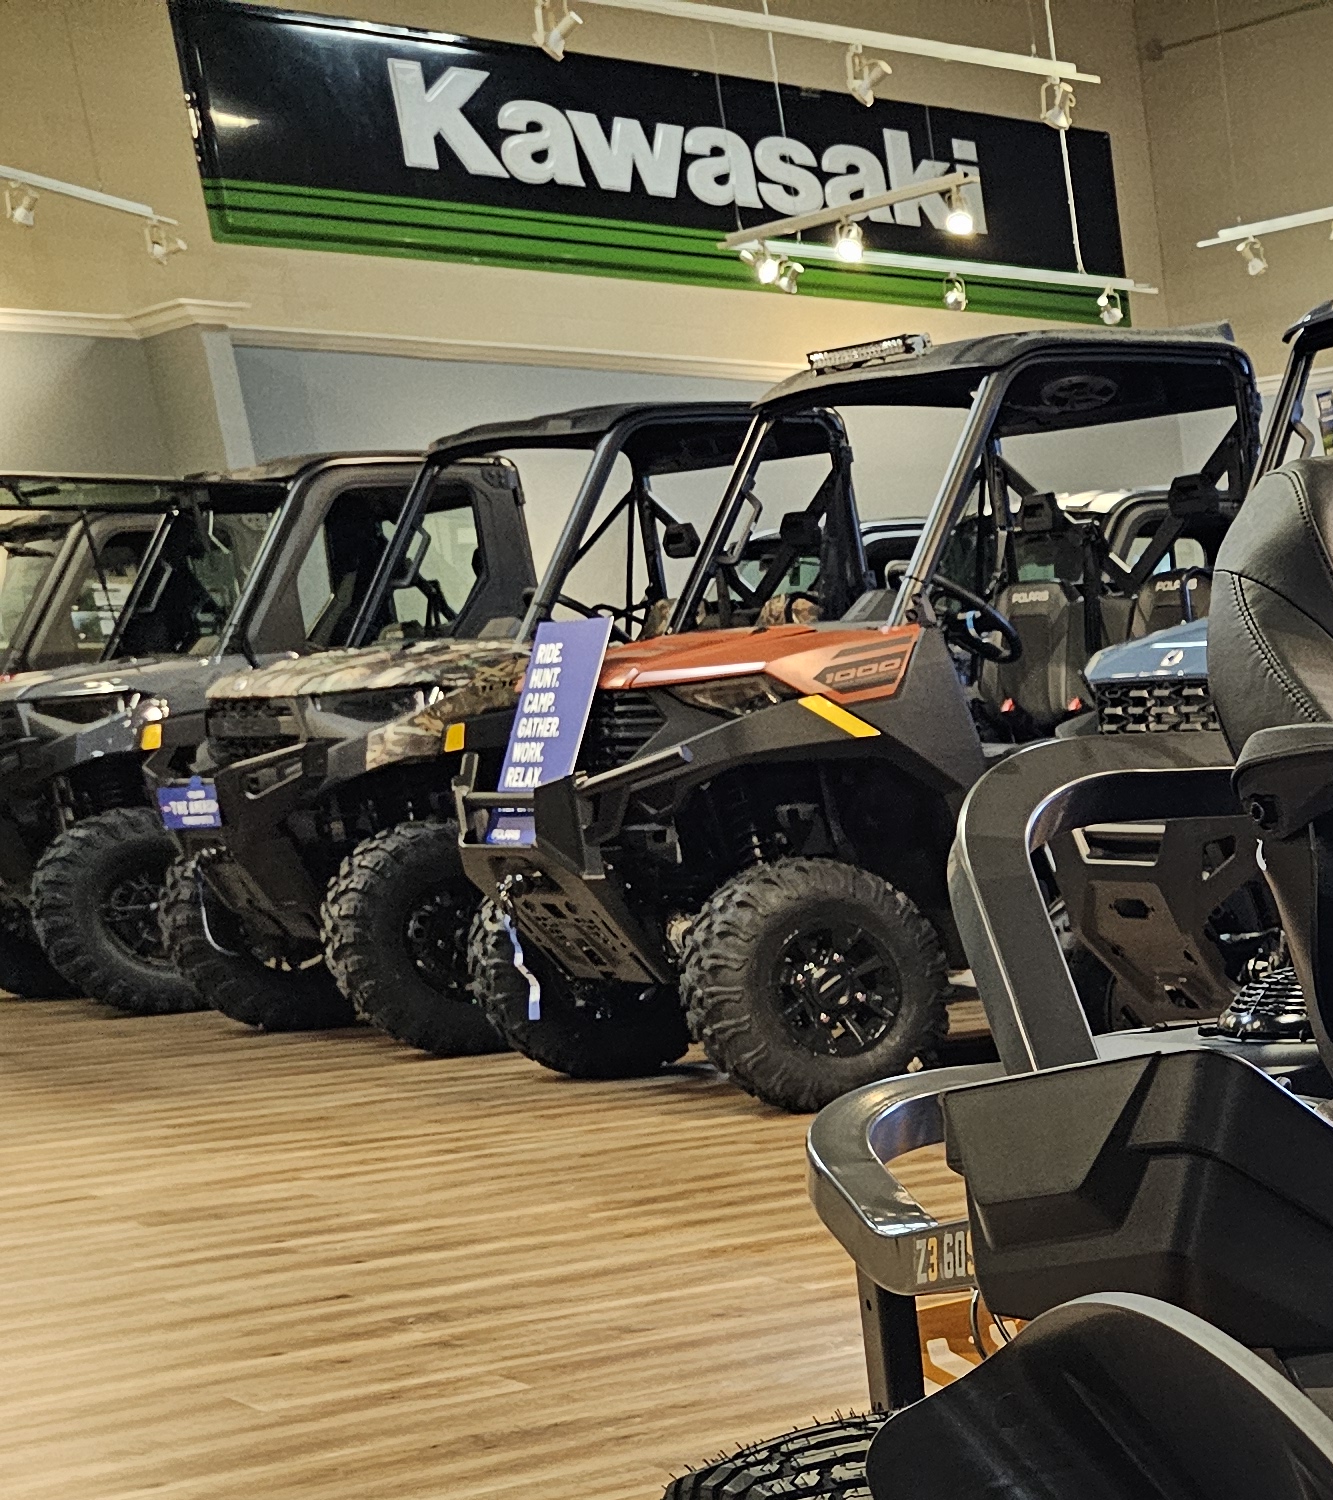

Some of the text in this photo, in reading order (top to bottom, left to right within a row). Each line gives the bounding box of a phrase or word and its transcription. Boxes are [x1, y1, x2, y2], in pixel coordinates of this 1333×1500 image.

[386, 58, 988, 235] Kawasaki
[1155, 577, 1198, 592] POLAIS
[1012, 590, 1049, 604] POLARIS
[535, 643, 563, 665] RIDE.
[528, 667, 562, 689] HUNT.
[825, 657, 901, 684] 1000
[522, 691, 556, 714] CAMP.
[516, 716, 560, 739] GATHER.
[511, 742, 545, 763] WORK.
[504, 767, 542, 788] RELAX.
[916, 1236, 938, 1285] Z3
